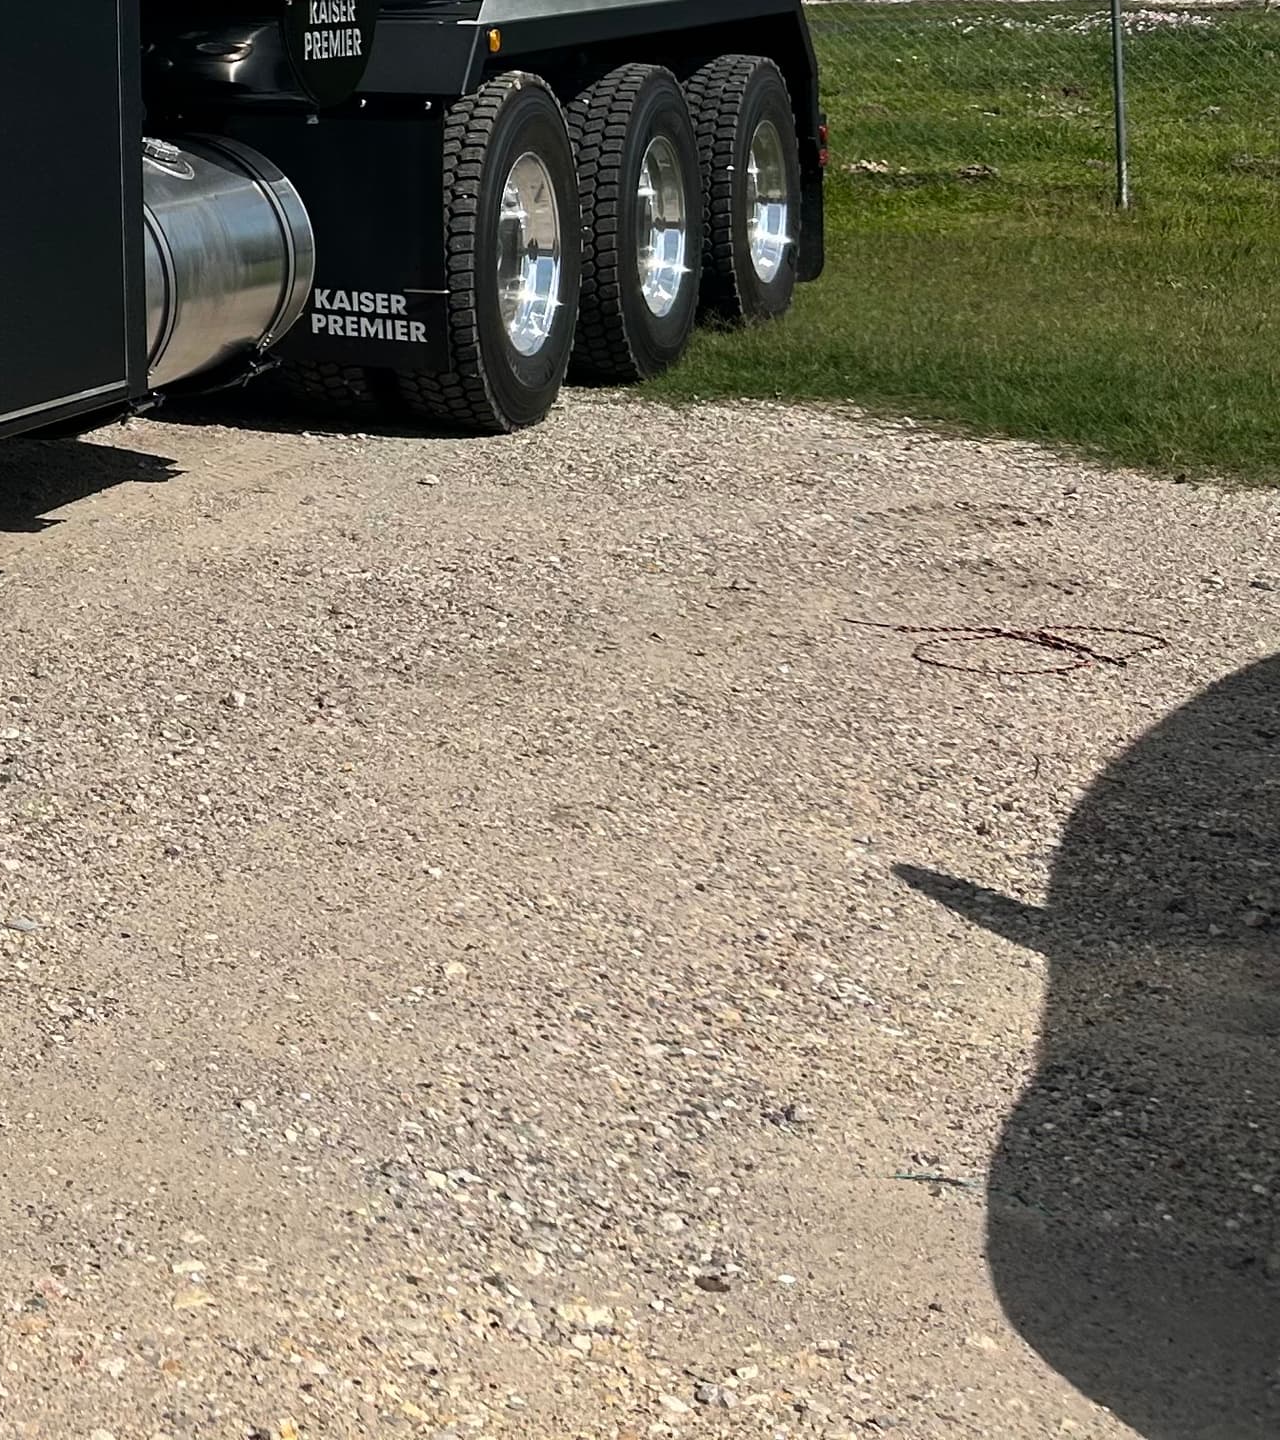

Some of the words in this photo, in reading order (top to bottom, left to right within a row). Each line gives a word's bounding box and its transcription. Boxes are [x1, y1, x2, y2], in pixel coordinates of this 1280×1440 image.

[304, 29, 363, 60] PREMIER
[314, 288, 409, 316] KAISER
[311, 313, 429, 343] PREMIER
